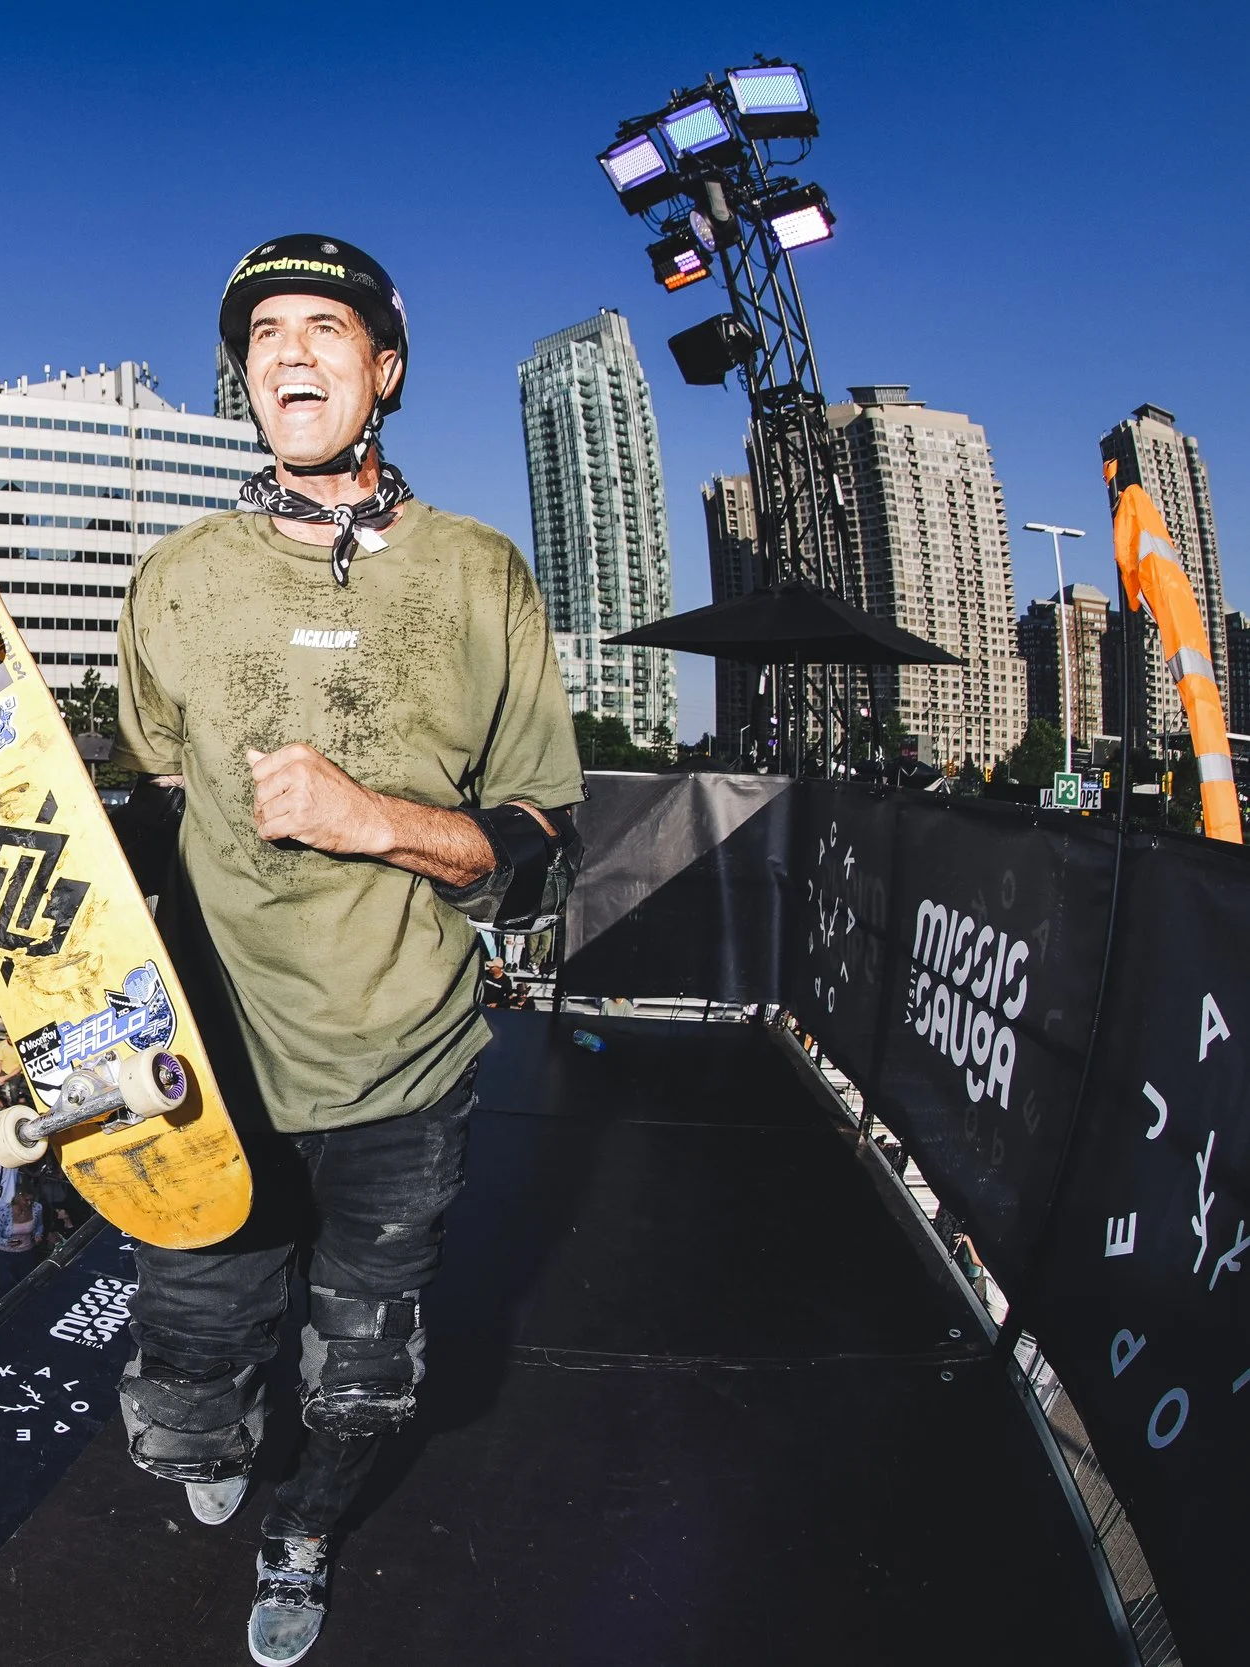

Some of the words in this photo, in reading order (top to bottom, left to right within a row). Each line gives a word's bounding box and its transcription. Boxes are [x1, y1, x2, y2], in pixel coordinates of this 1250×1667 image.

[290, 628, 359, 649] JACKALOPE
[1042, 790, 1099, 808] JAOPE
[1058, 780, 1076, 800] P3
[912, 898, 1030, 1020] MISSIS
[25, 1029, 57, 1051] MoonPay
[62, 1009, 147, 1067] PAULO
[914, 971, 1016, 1110] SAUGA
[49, 1278, 123, 1342] MISSIS
[75, 1338, 103, 1350] VISIT
